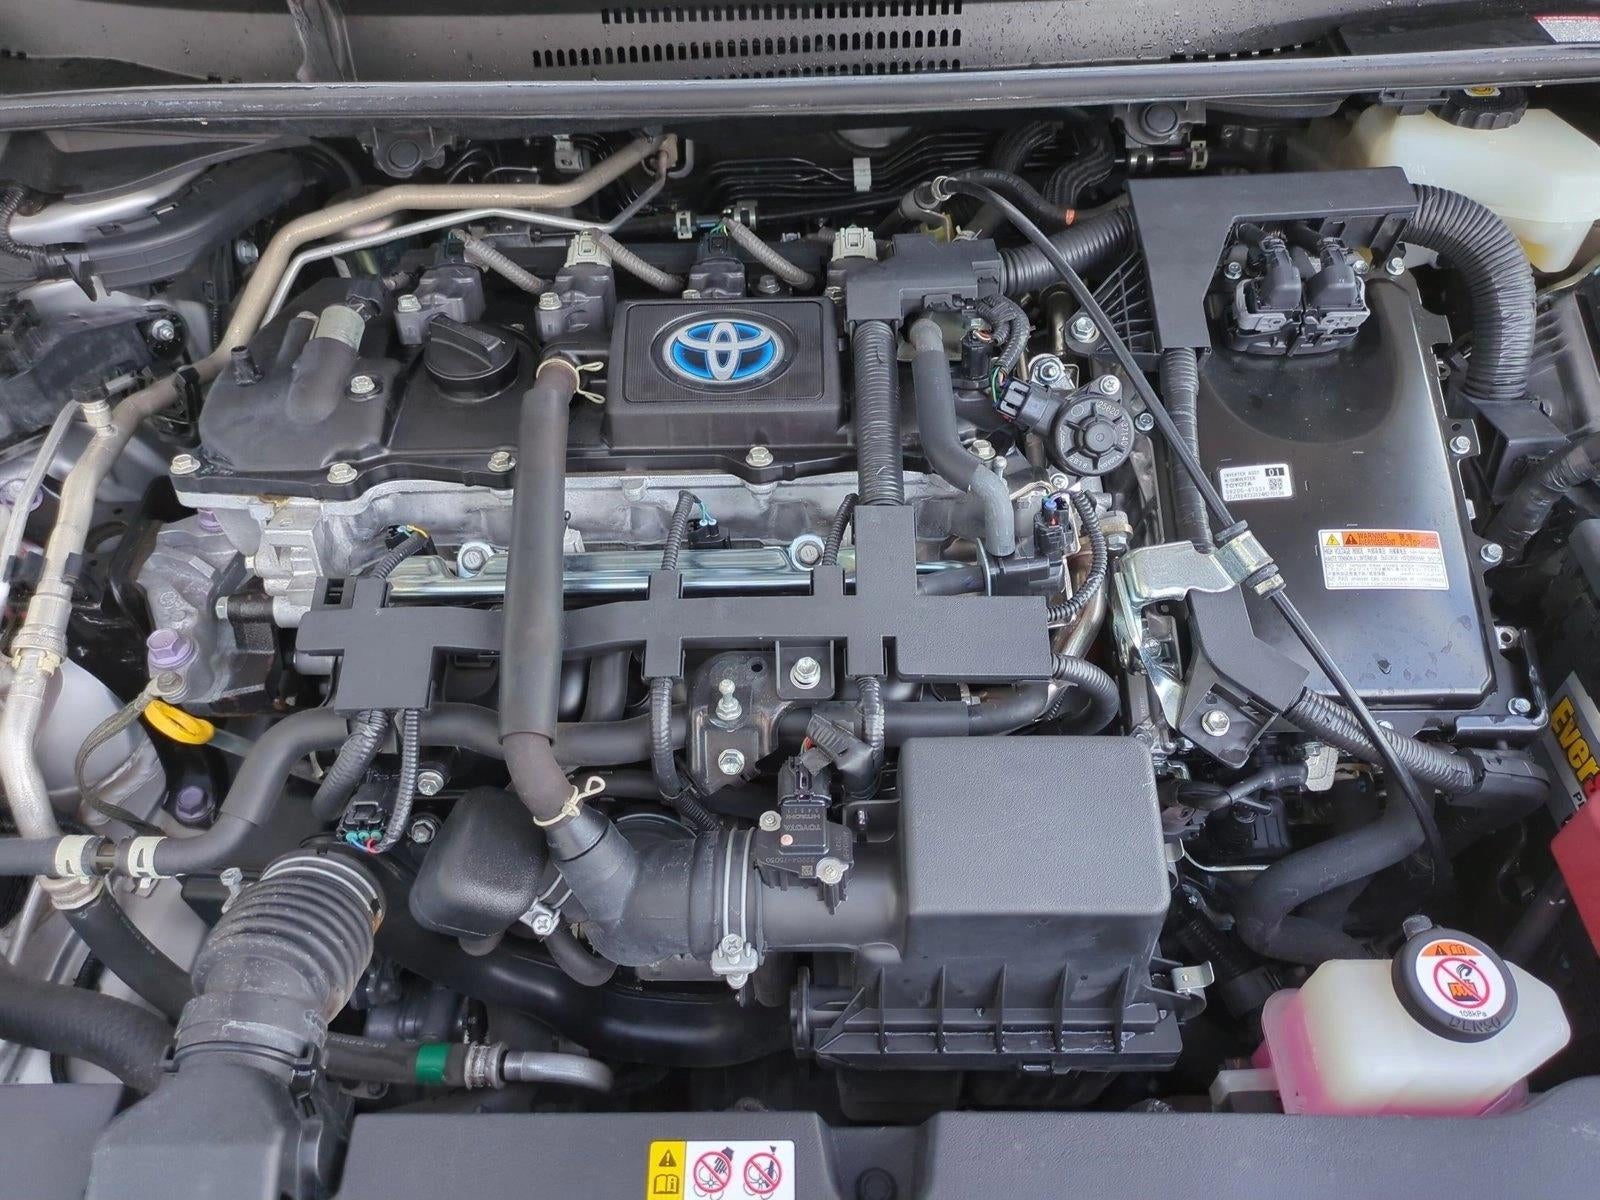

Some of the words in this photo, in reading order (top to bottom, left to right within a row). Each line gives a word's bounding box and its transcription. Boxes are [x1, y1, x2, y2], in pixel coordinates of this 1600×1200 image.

[1097, 401, 1120, 417] 25620
[1099, 455, 1121, 469] TOYOTA
[1358, 532, 1387, 540] WARNING
[783, 823, 822, 831] TOYOTA
[1458, 1010, 1487, 1018] 108kPa
[1448, 1016, 1501, 1032] DENSO
